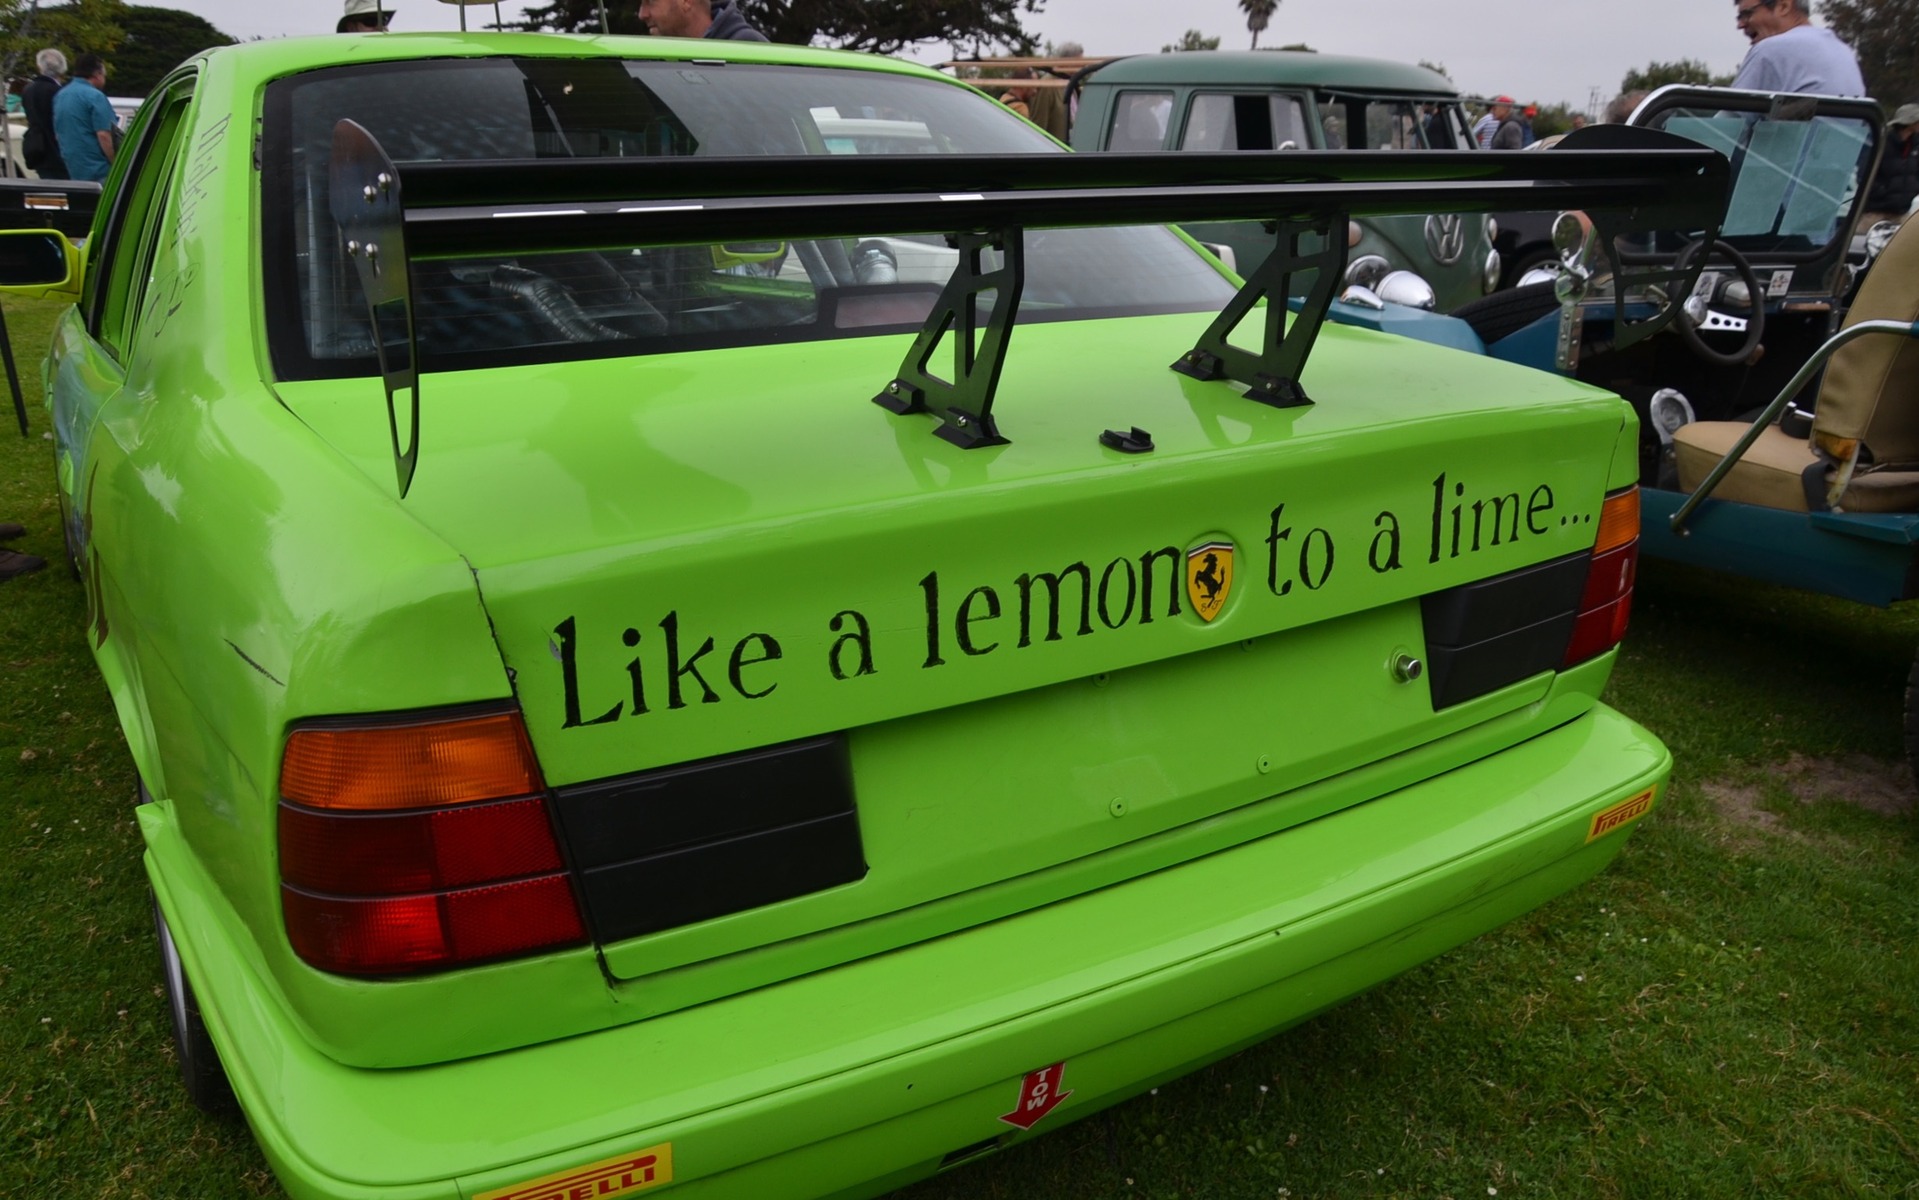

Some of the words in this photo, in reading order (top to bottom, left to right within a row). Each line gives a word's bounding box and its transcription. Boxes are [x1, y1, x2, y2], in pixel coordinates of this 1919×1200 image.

[553, 610, 782, 729] Like
[828, 610, 878, 680] a
[918, 545, 1182, 668] lemon
[1264, 503, 1334, 596] to
[1368, 510, 1403, 574] a
[1428, 471, 1591, 564] lime...
[1591, 791, 1652, 837] PIRELLI
[1026, 1066, 1052, 1112] TOW
